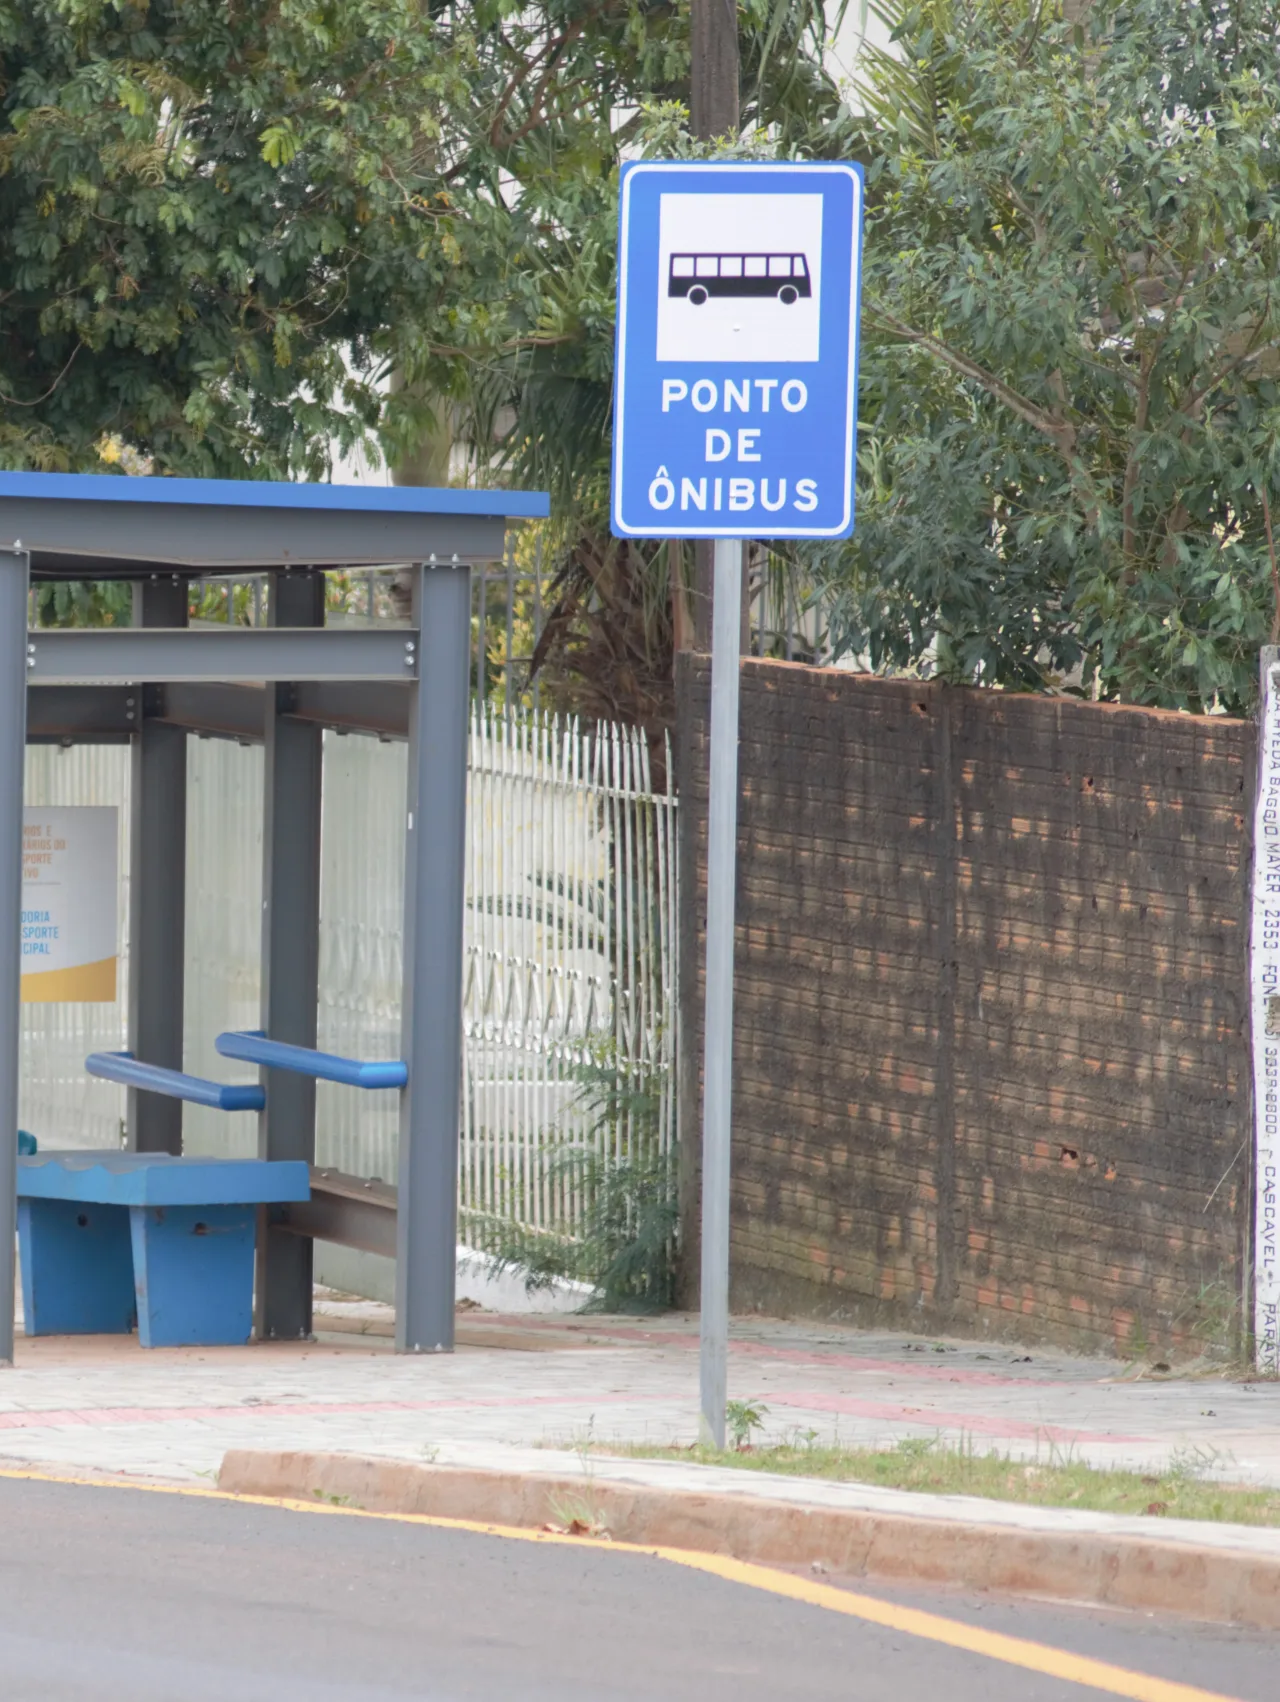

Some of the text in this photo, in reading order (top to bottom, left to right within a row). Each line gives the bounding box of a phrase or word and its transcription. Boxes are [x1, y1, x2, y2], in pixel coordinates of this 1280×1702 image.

[662, 379, 808, 413] PONTO
[705, 429, 762, 462] DE
[648, 465, 819, 512] ÔNIBUS
[1266, 842, 1280, 893] MAYER
[1263, 909, 1280, 950] 2353
[1263, 1165, 1277, 1268] CASCAVEL
